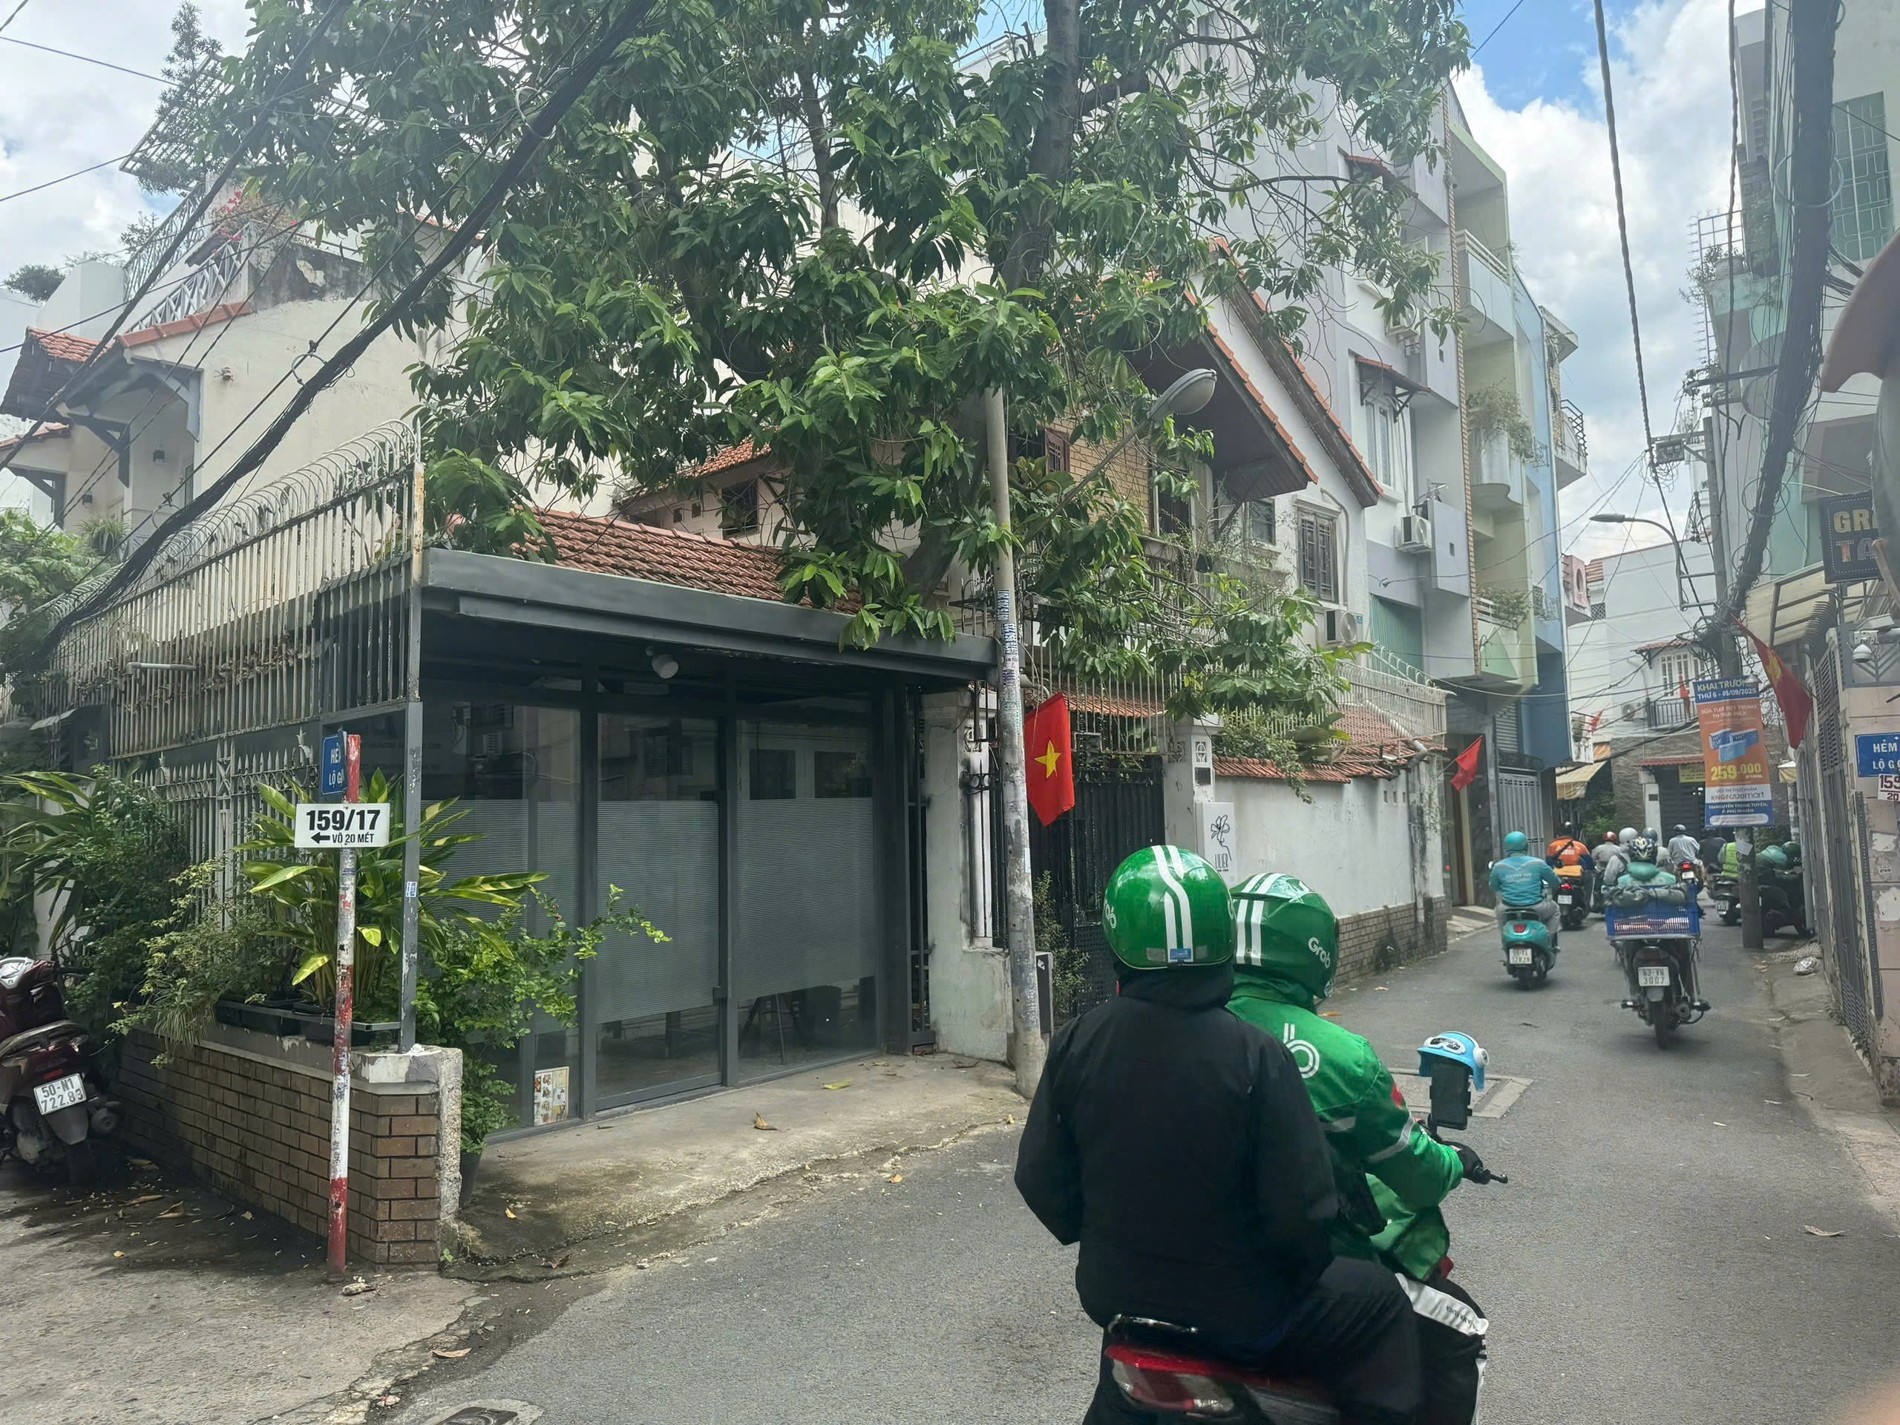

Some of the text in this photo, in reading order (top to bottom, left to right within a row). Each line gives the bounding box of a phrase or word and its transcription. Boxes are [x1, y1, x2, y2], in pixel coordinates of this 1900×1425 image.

[1833, 508, 1877, 533] GR
[1697, 682, 1717, 692] KHAI
[1697, 691, 1711, 700] THỨ
[331, 742, 341, 764] HẺ
[1873, 739, 1898, 753] HẺM
[1711, 763, 1762, 781] 259.000
[1872, 758, 1885, 772] LỘ
[306, 809, 380, 831] 159/17
[332, 832, 374, 844] VÔ 20 MÉT
[1308, 936, 1330, 969] Grab
[41, 1078, 74, 1098] 50-N1
[41, 1088, 83, 1112] 722.83
